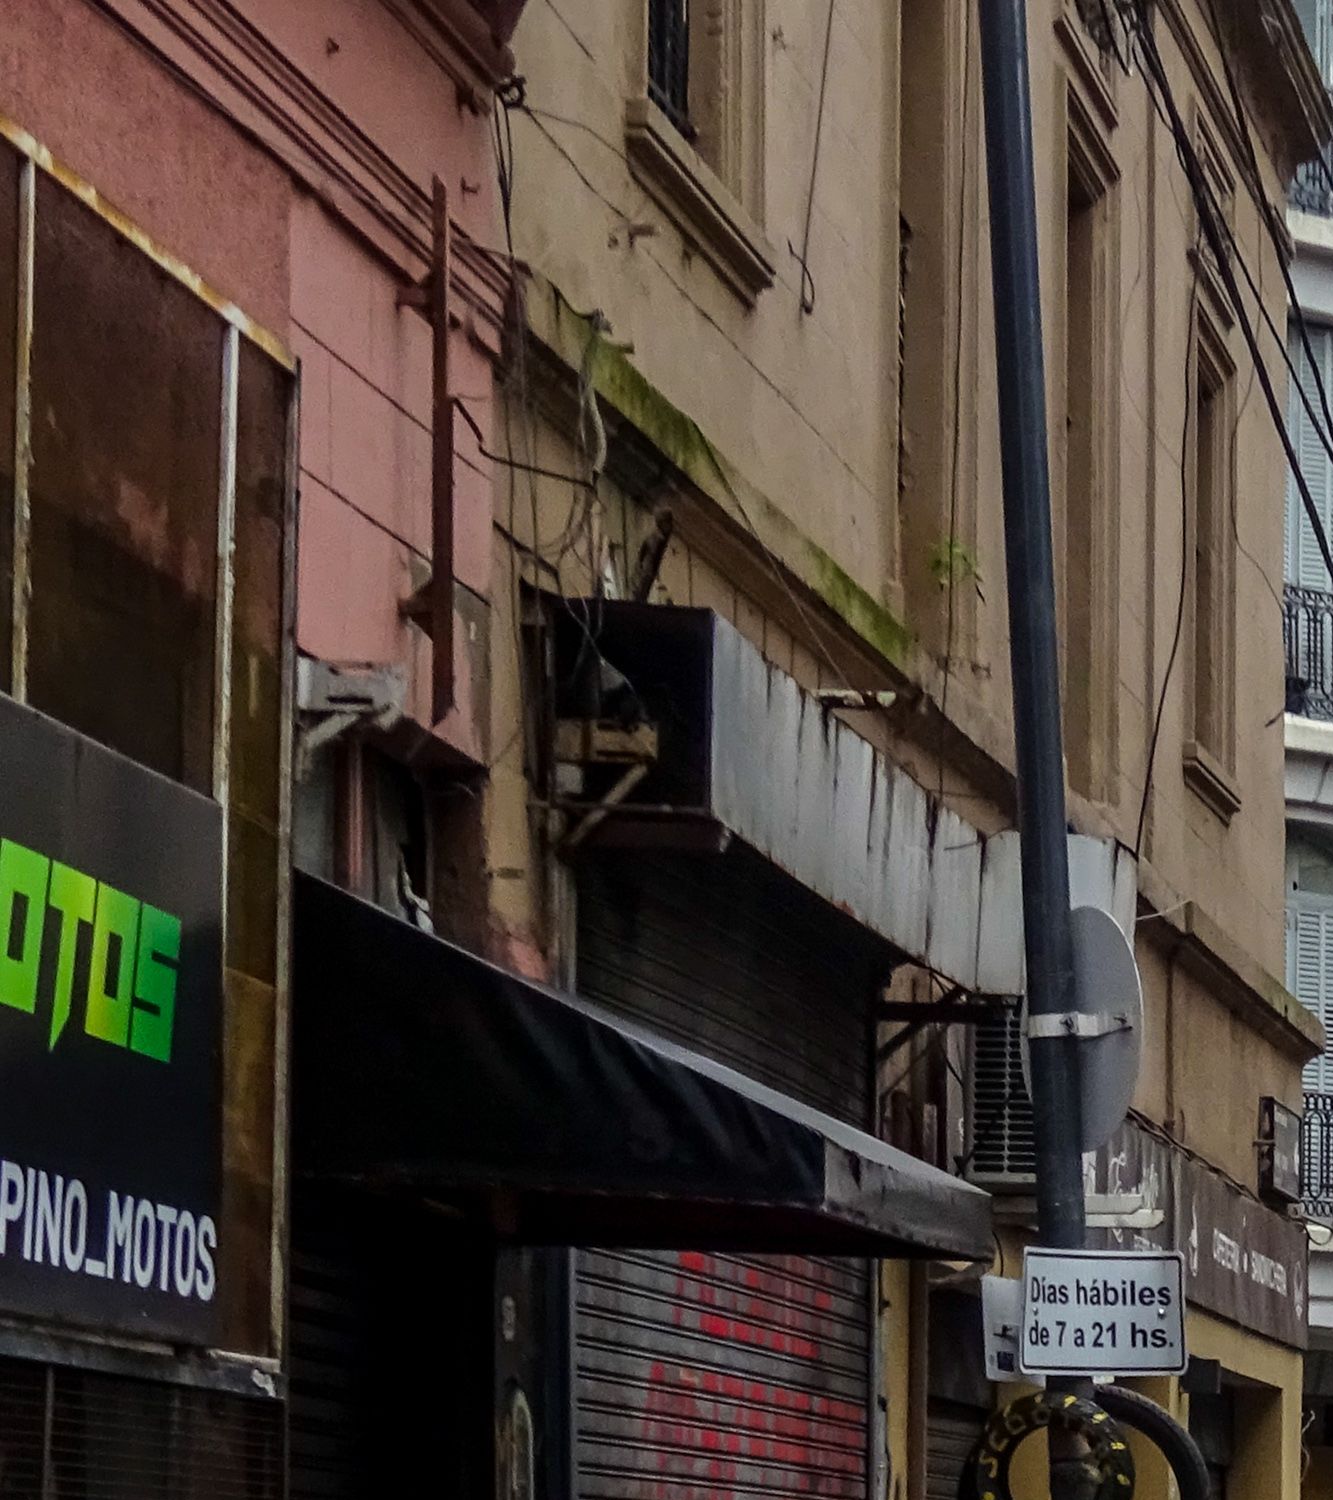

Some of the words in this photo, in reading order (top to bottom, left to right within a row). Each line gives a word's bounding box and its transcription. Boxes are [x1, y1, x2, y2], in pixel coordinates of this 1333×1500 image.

[1030, 1276, 1069, 1305] Días
[1076, 1279, 1171, 1307] hábiles
[1029, 1319, 1050, 1346] de
[1055, 1321, 1067, 1347] 7
[1073, 1326, 1085, 1347] a
[1092, 1321, 1117, 1347] 21
[1131, 1321, 1174, 1349] hs.
